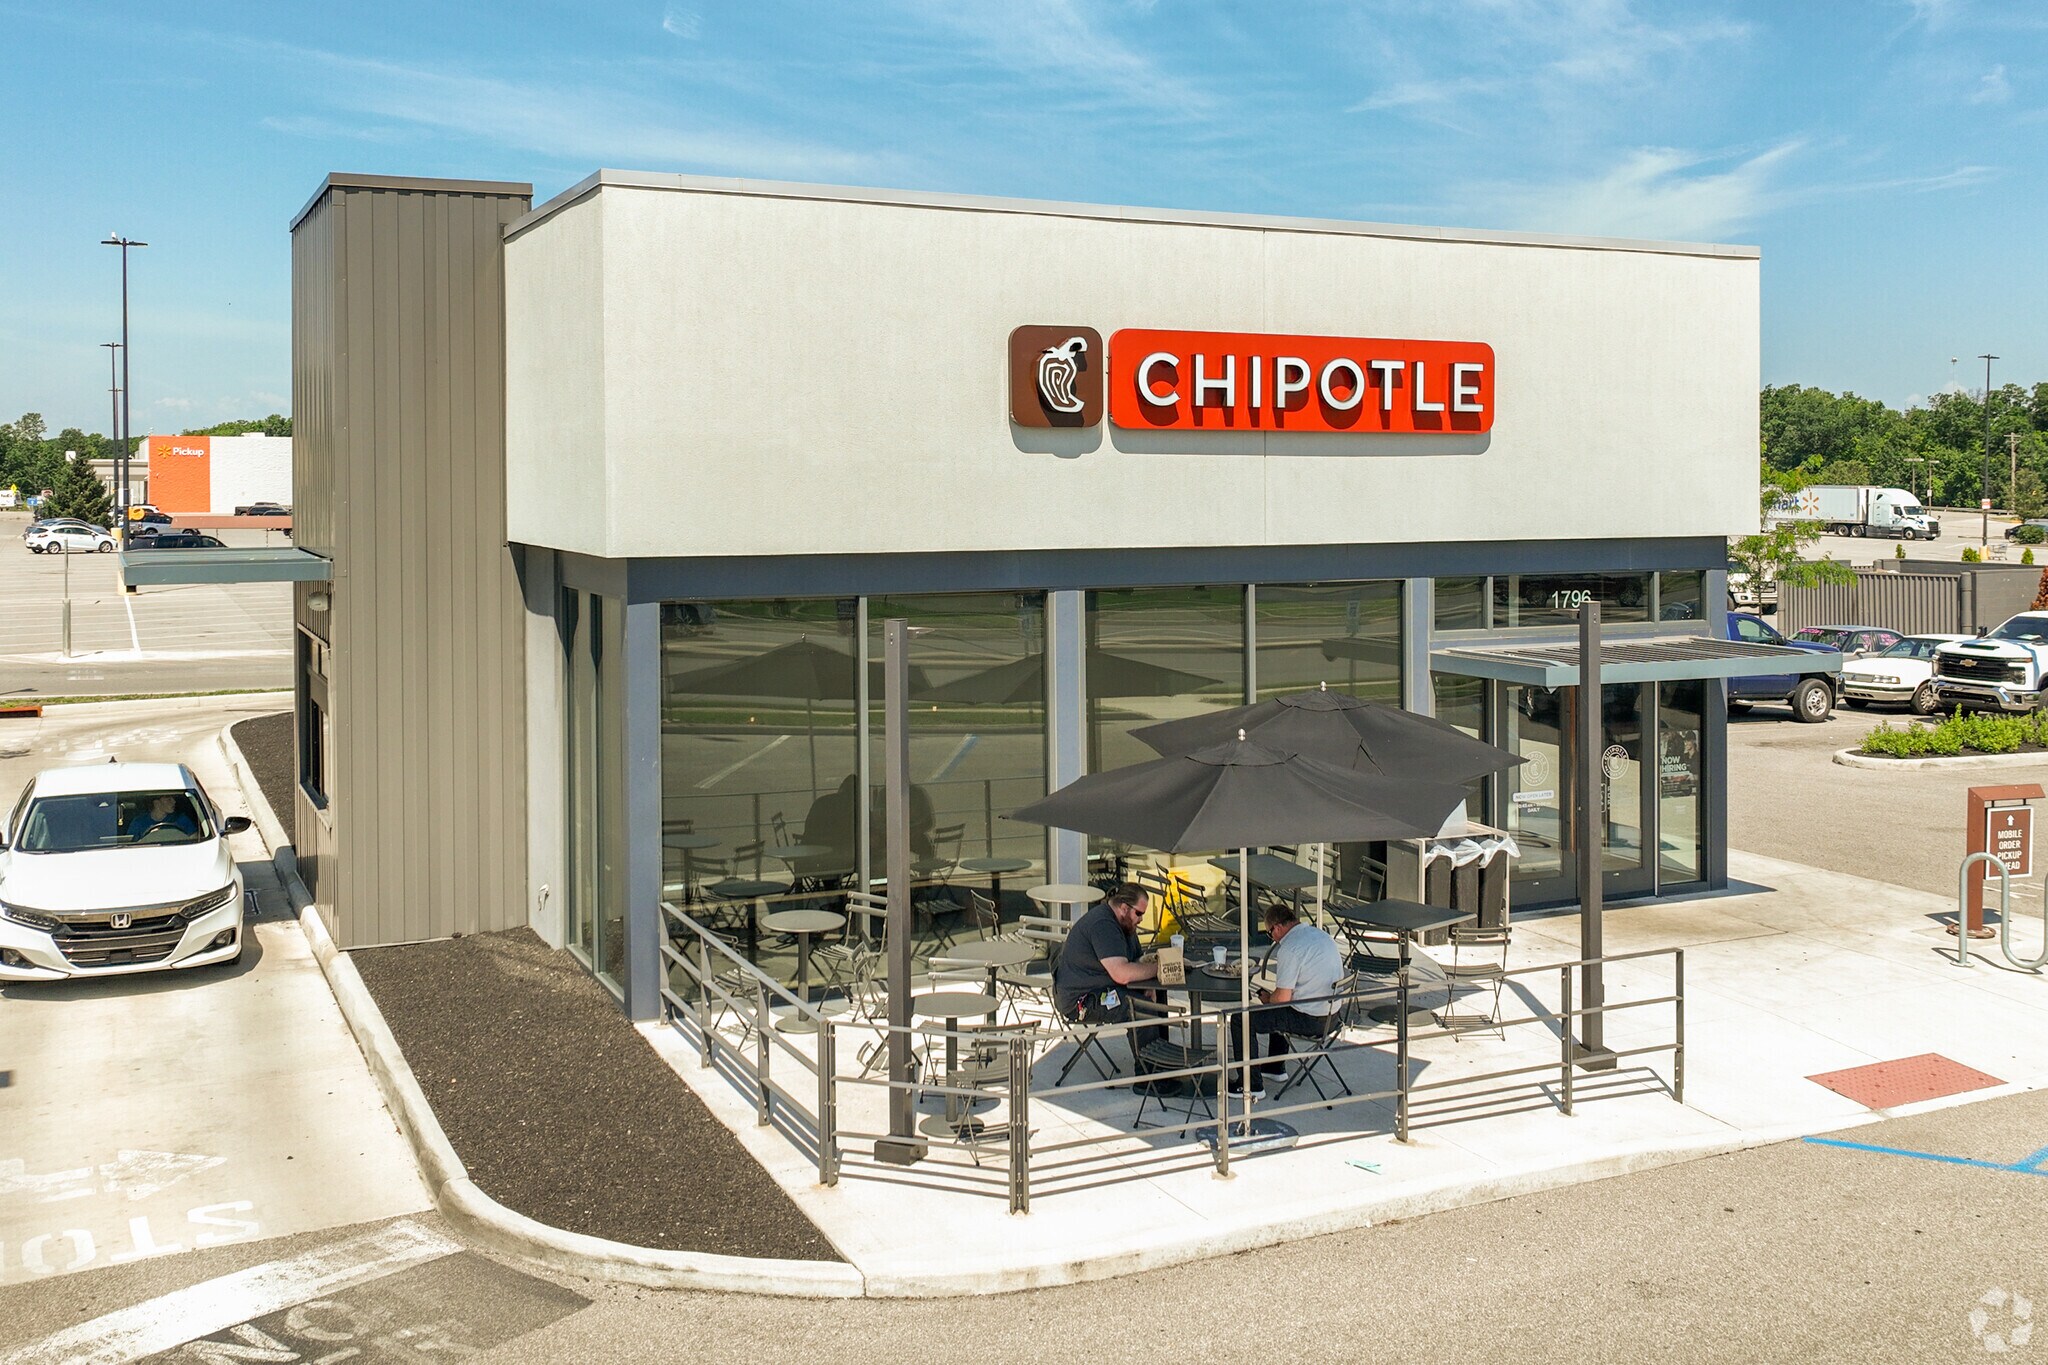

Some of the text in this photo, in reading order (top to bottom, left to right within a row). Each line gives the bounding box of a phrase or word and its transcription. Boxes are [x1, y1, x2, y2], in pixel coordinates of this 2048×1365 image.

[1138, 352, 1484, 412] CHIPOTLE
[172, 447, 204, 457] Pickup
[1552, 590, 1591, 609] 1796
[1661, 756, 1680, 765] NOW
[1661, 763, 1687, 772] HIRING
[1998, 830, 2023, 839] MOBILE
[1999, 840, 2021, 850] ORDER
[1998, 851, 2022, 860] PICKUP
[1162, 966, 1182, 974] CHIPS
[0, 1200, 260, 1281] STO
